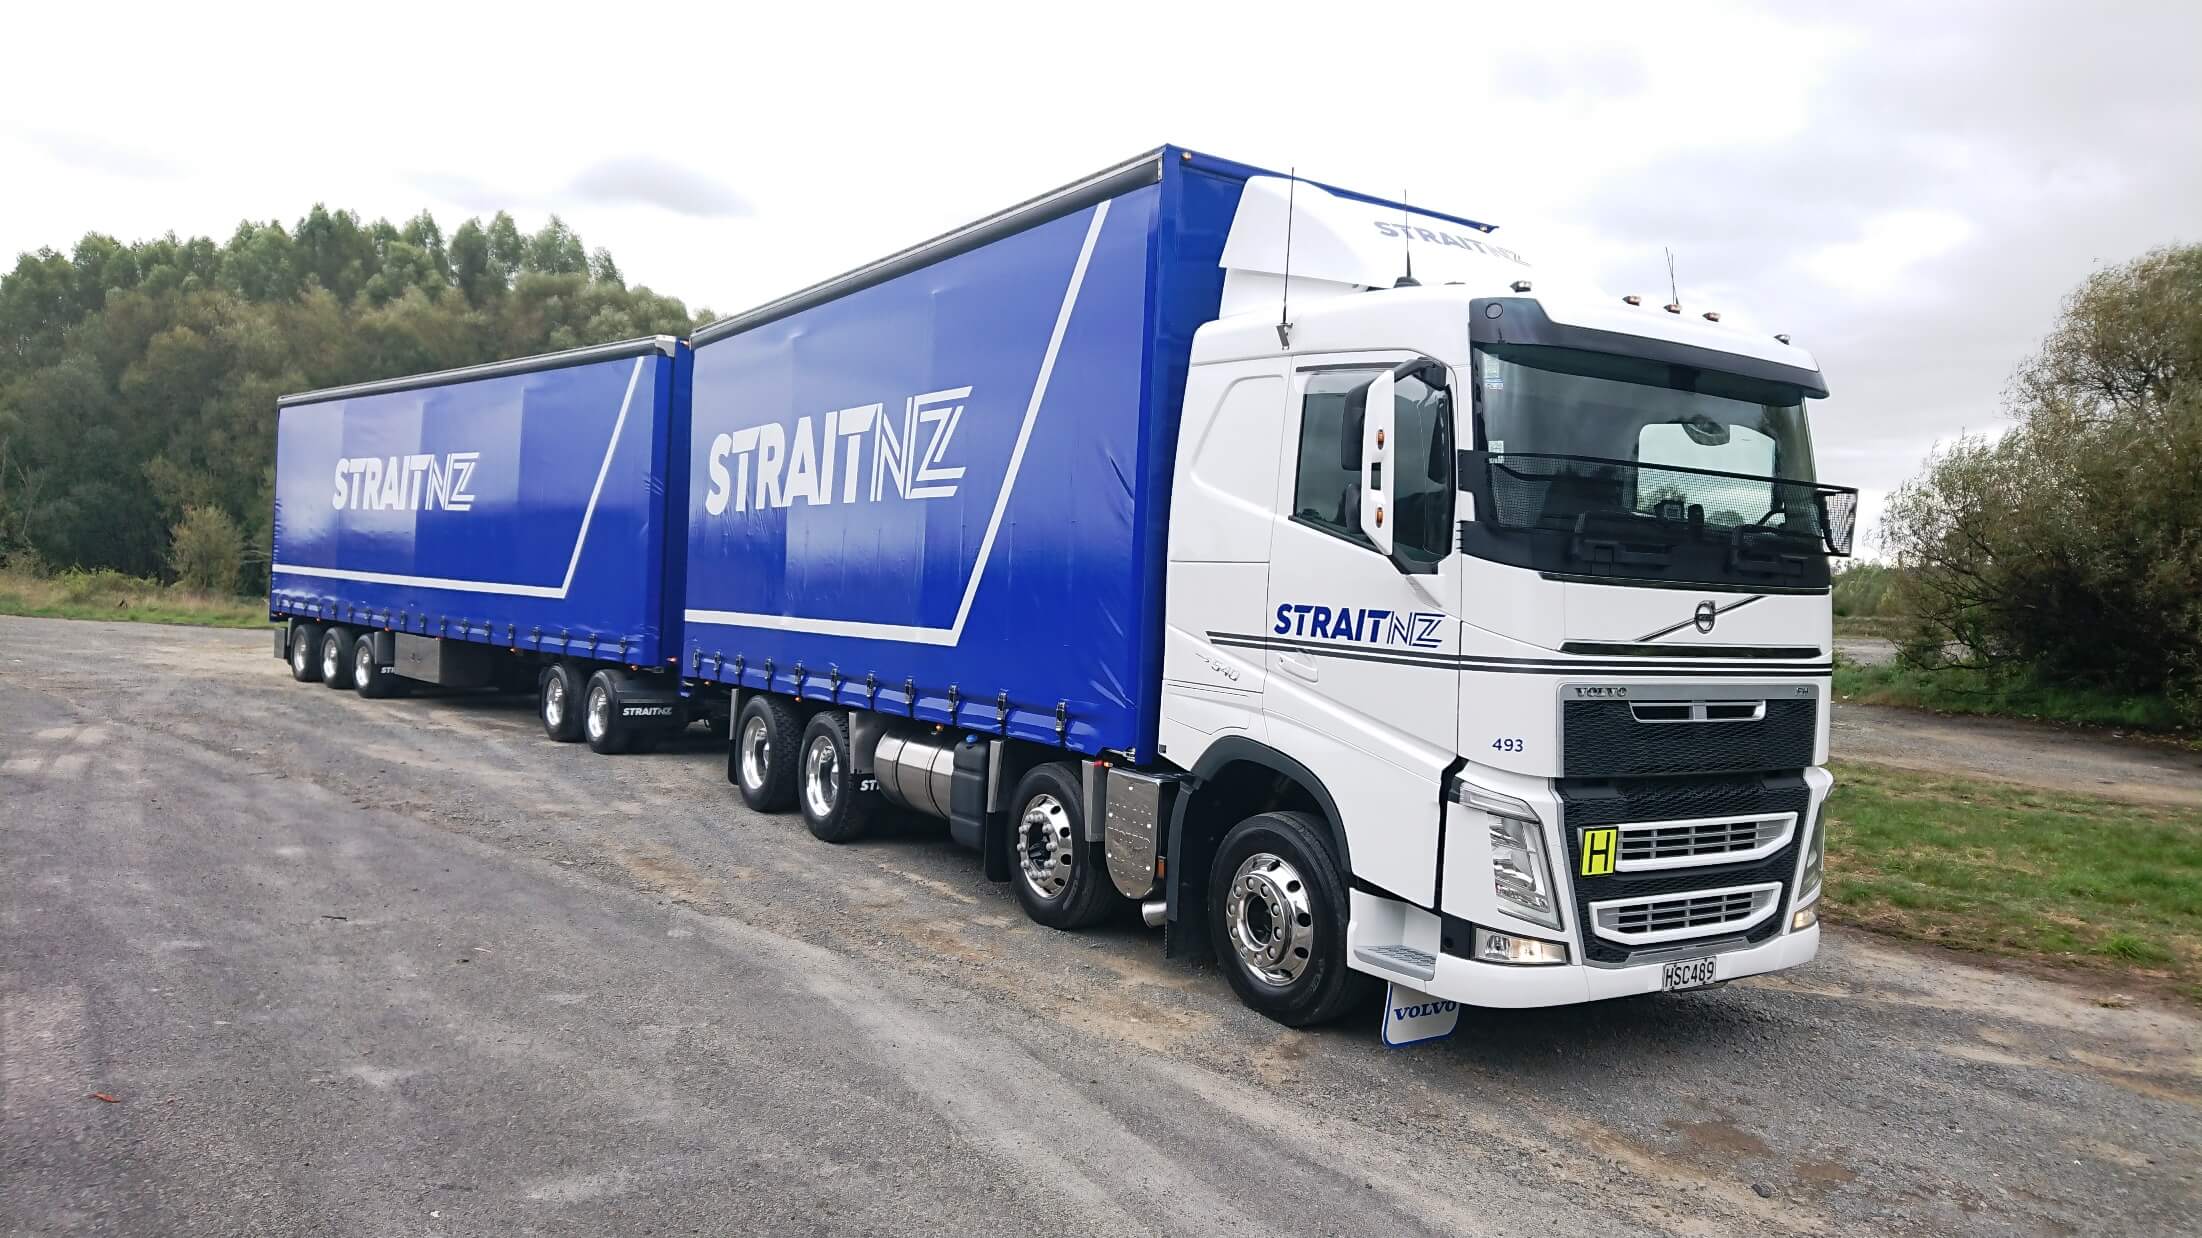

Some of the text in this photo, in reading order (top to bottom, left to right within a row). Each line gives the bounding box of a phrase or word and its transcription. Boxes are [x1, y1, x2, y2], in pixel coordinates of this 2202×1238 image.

[1575, 686, 1627, 697] VOLVO
[1492, 738, 1523, 752] 493
[1588, 831, 1611, 873] H
[1665, 961, 1715, 988] HSC489
[1394, 1000, 1457, 1020] VOLVO
